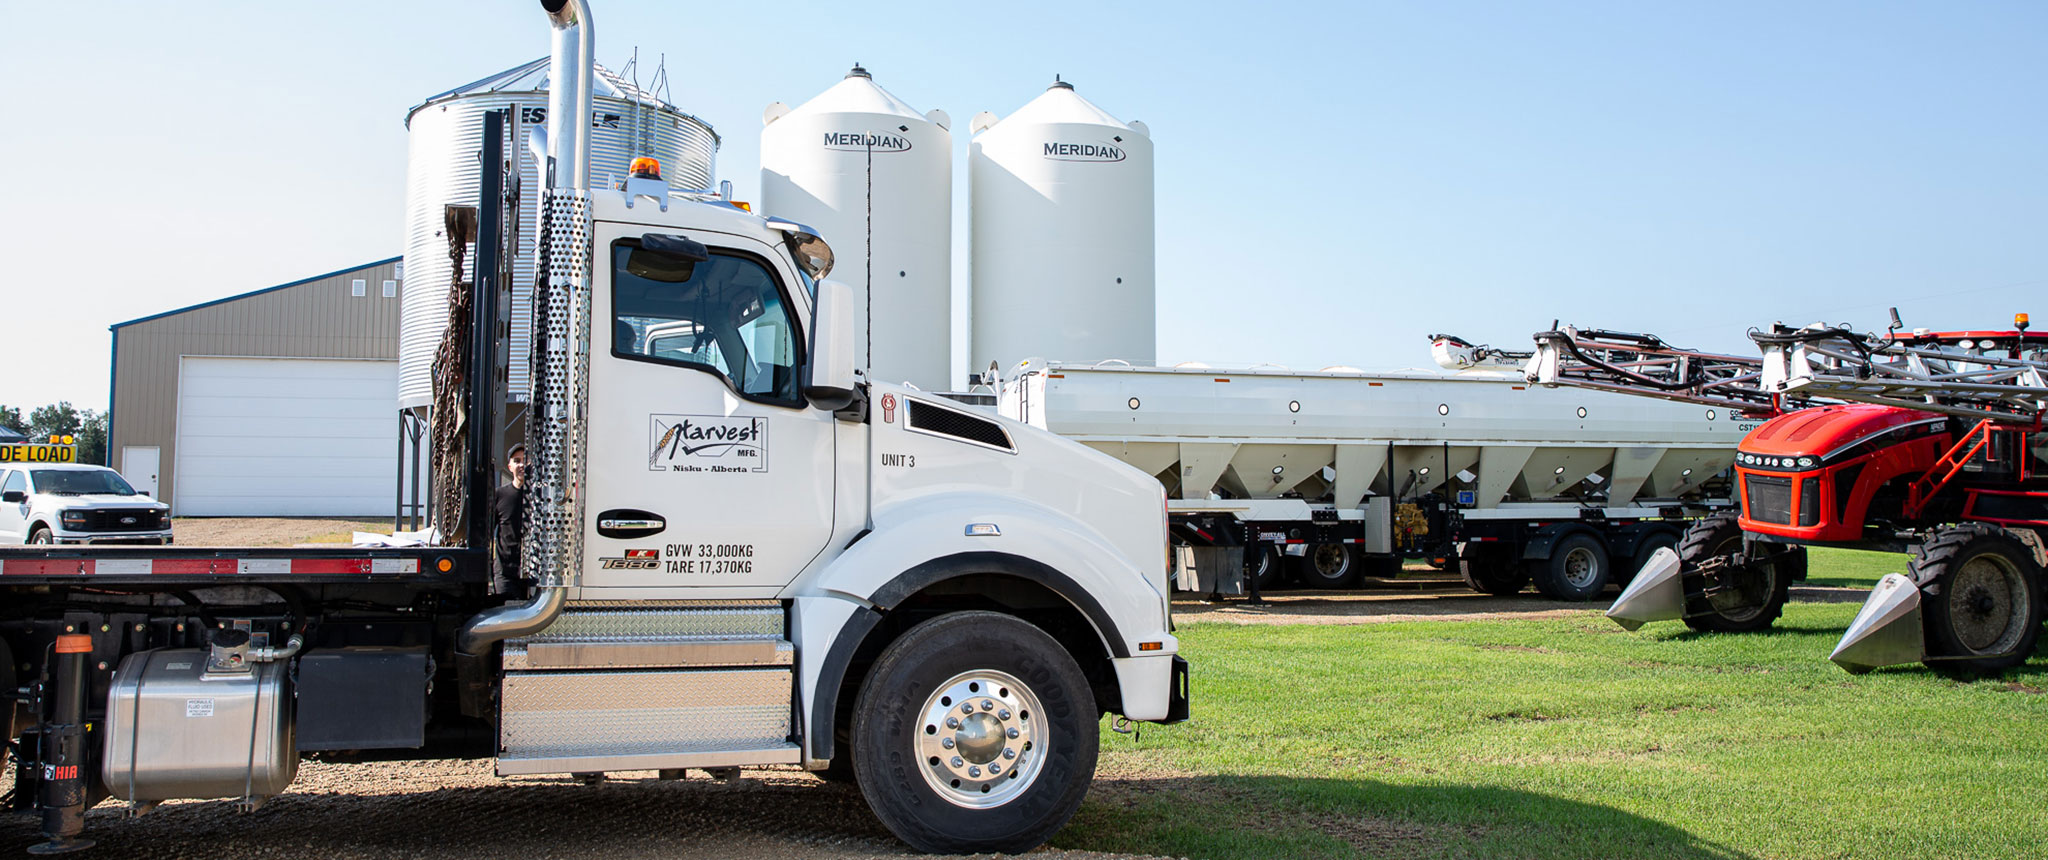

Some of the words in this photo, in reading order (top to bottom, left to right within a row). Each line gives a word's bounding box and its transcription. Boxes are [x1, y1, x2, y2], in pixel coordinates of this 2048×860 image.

[824, 132, 903, 150] MERIDIAN
[1043, 142, 1119, 160] MERIDIAN
[27, 446, 71, 462] LOAD
[737, 449, 758, 457] MFG.
[881, 453, 906, 467] UNIT
[908, 455, 916, 467] 3
[711, 465, 748, 473] Alberta
[665, 543, 693, 557] GVW
[698, 544, 753, 559] 33,000KG
[599, 557, 661, 570] T880
[665, 561, 695, 574] TARE
[699, 561, 752, 575] 17,370KG
[1014, 656, 1076, 821] GOODYEAR
